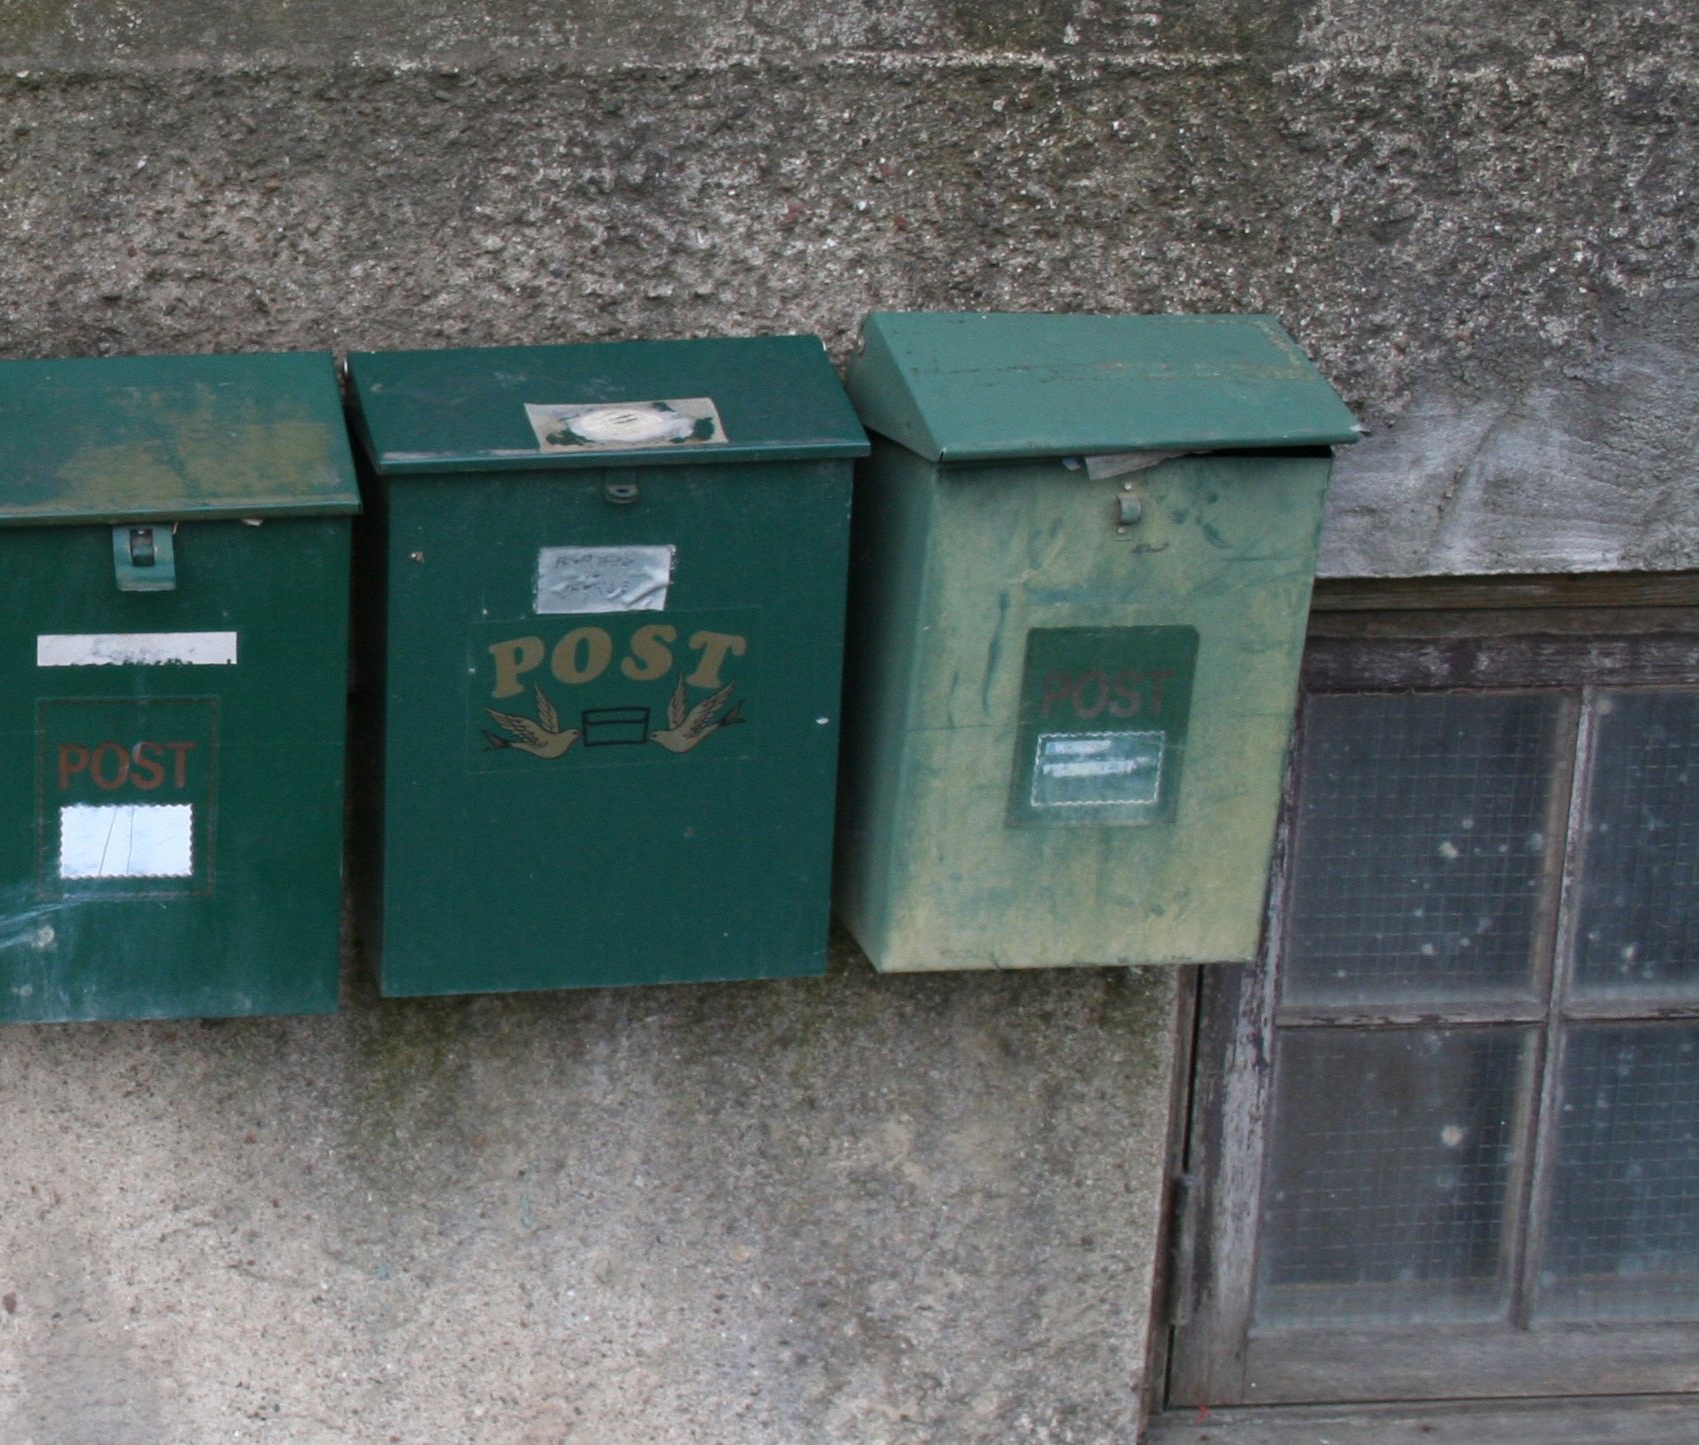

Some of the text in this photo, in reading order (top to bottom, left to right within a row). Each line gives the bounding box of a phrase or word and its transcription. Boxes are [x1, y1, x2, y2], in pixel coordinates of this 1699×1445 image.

[487, 623, 747, 699] POST
[1040, 667, 1176, 719] POST
[57, 740, 199, 790] POST
